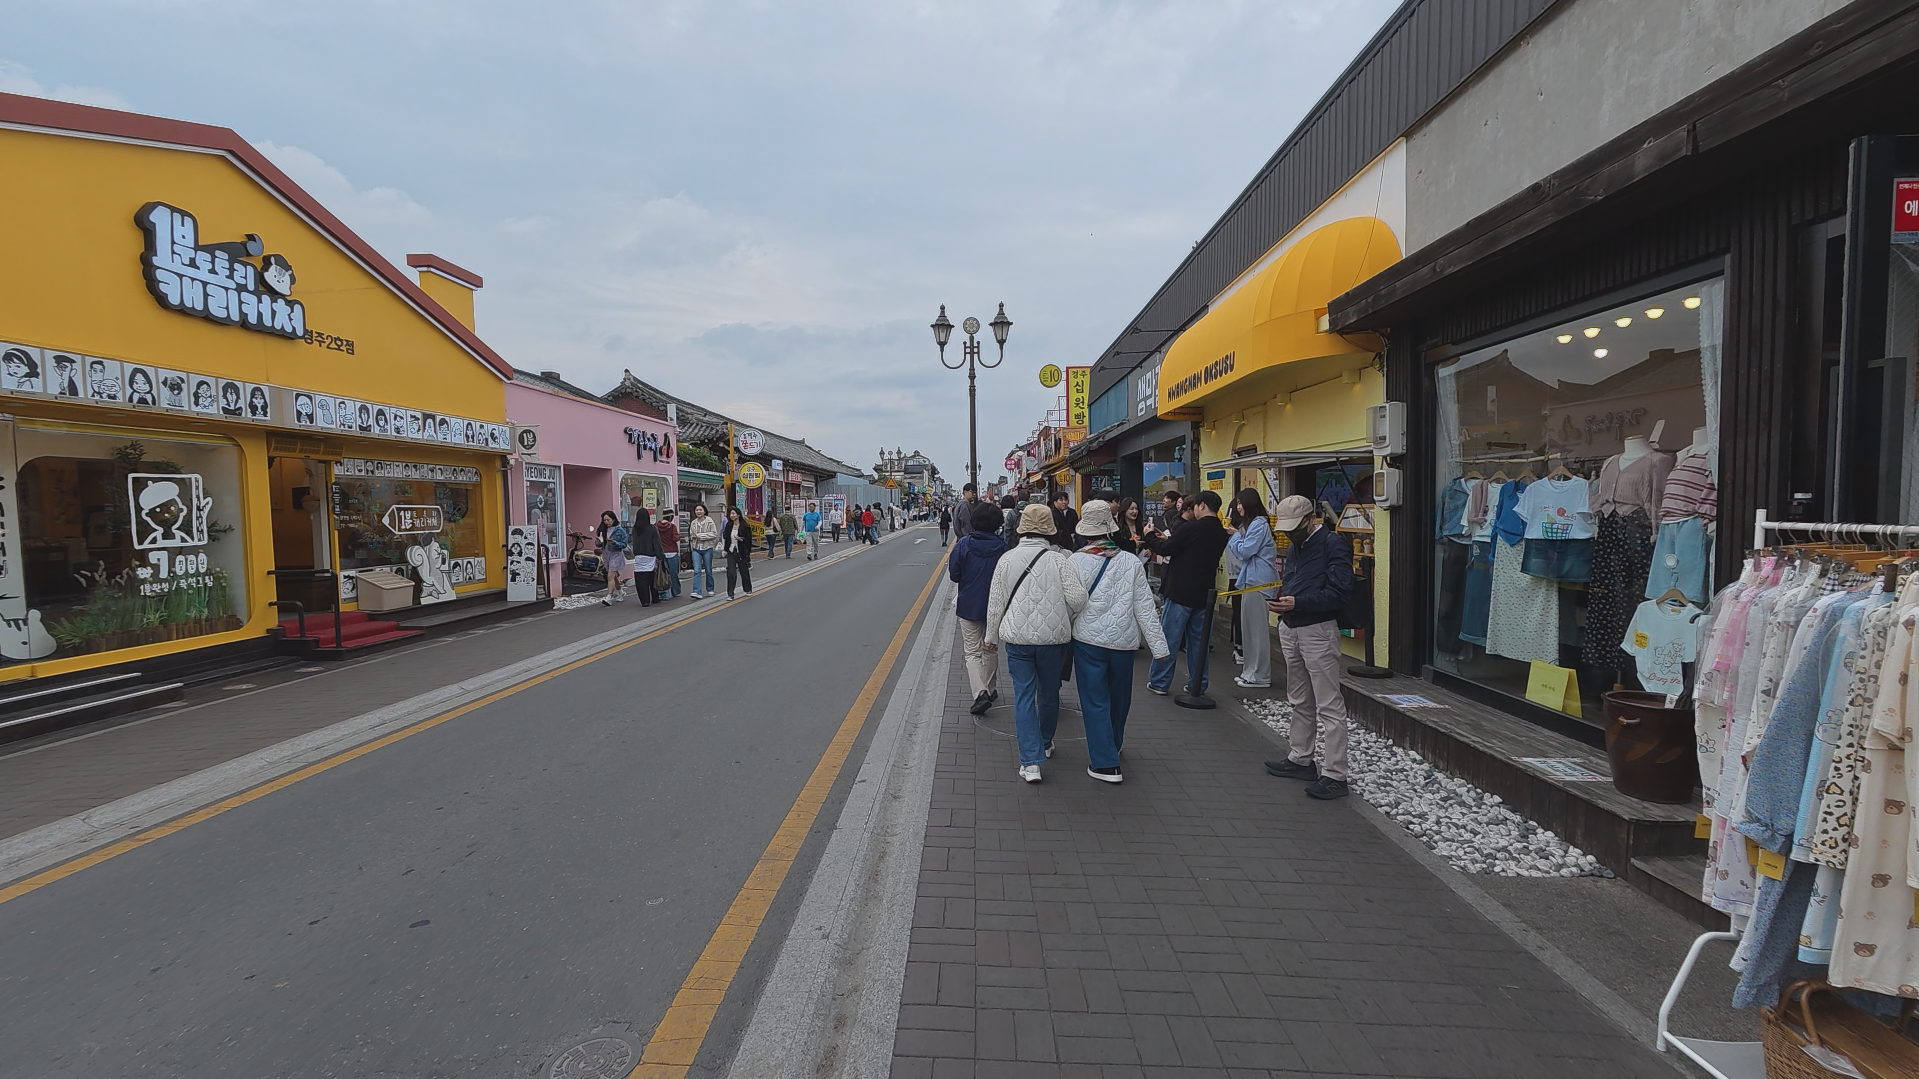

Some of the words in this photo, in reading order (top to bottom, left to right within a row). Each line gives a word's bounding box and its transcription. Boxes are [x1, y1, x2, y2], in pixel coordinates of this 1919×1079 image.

[1049, 369, 1060, 383] 10
[1072, 370, 1088, 379] 경주
[1203, 350, 1236, 385] OKSUSU
[1073, 379, 1087, 425] 십원빵
